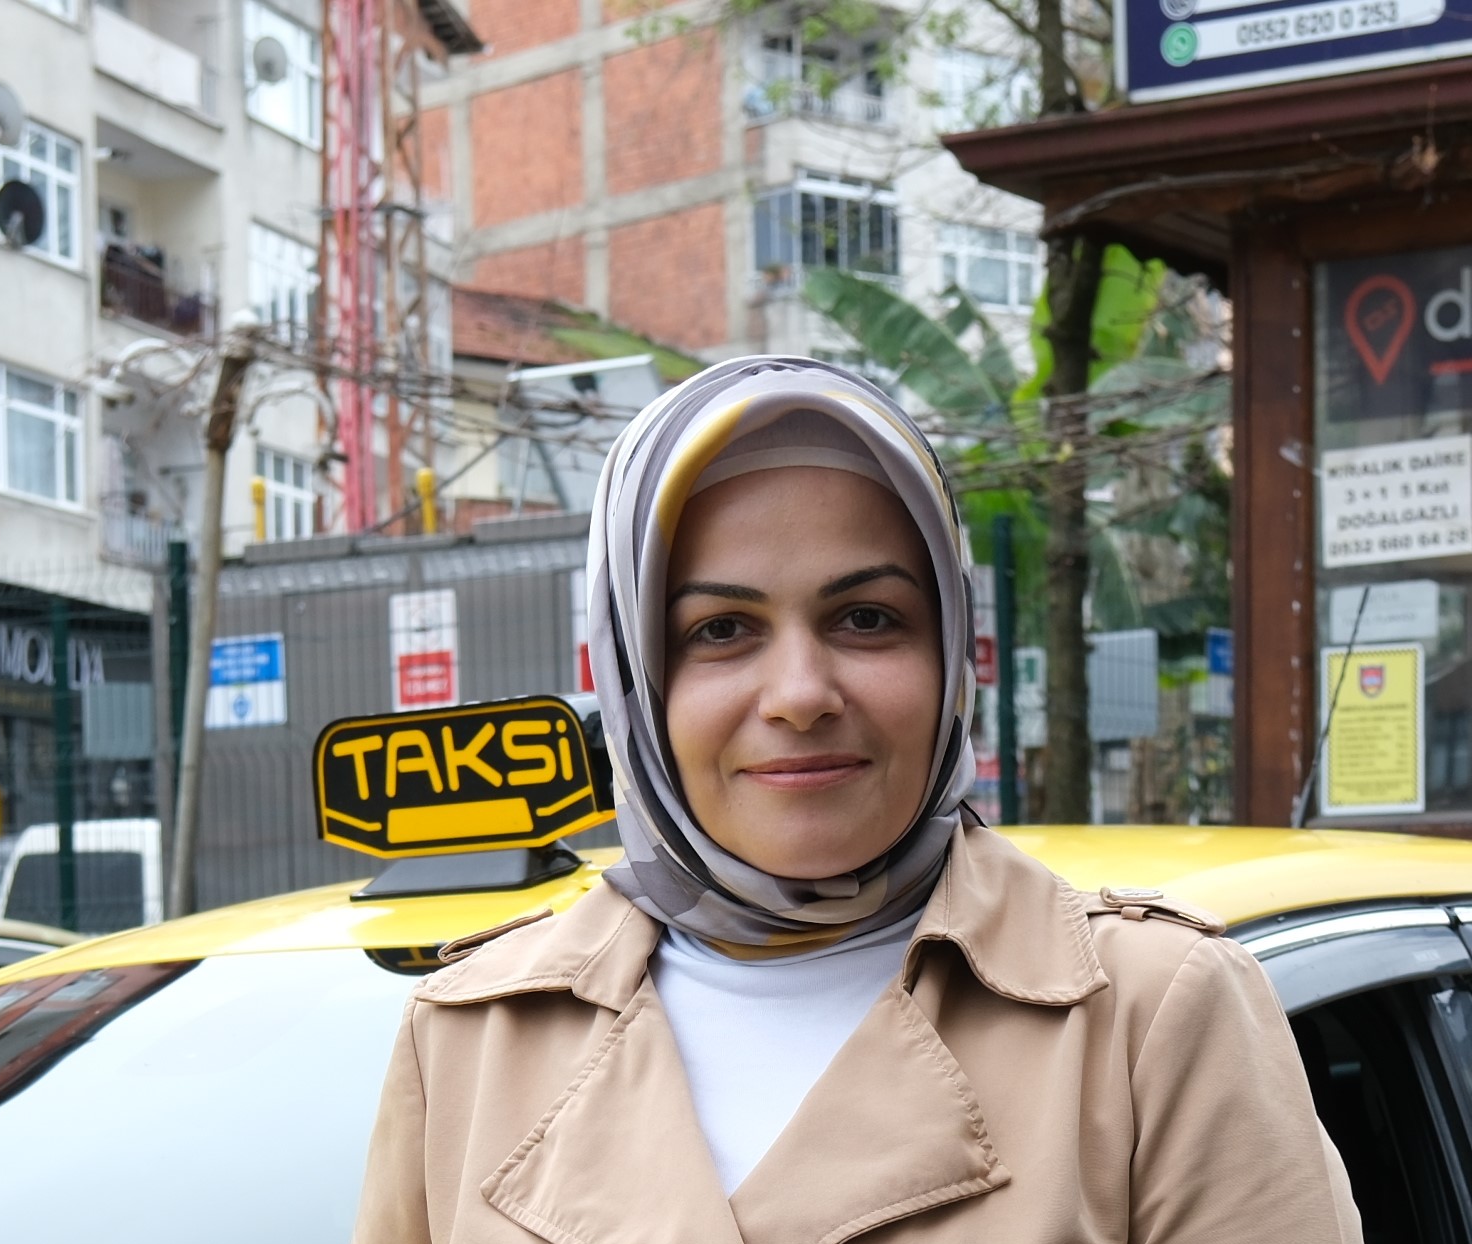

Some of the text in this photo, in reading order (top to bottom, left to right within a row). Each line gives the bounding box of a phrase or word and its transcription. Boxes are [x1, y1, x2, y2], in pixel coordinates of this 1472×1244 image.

[1236, 1, 1400, 46] 0552 620 0 253
